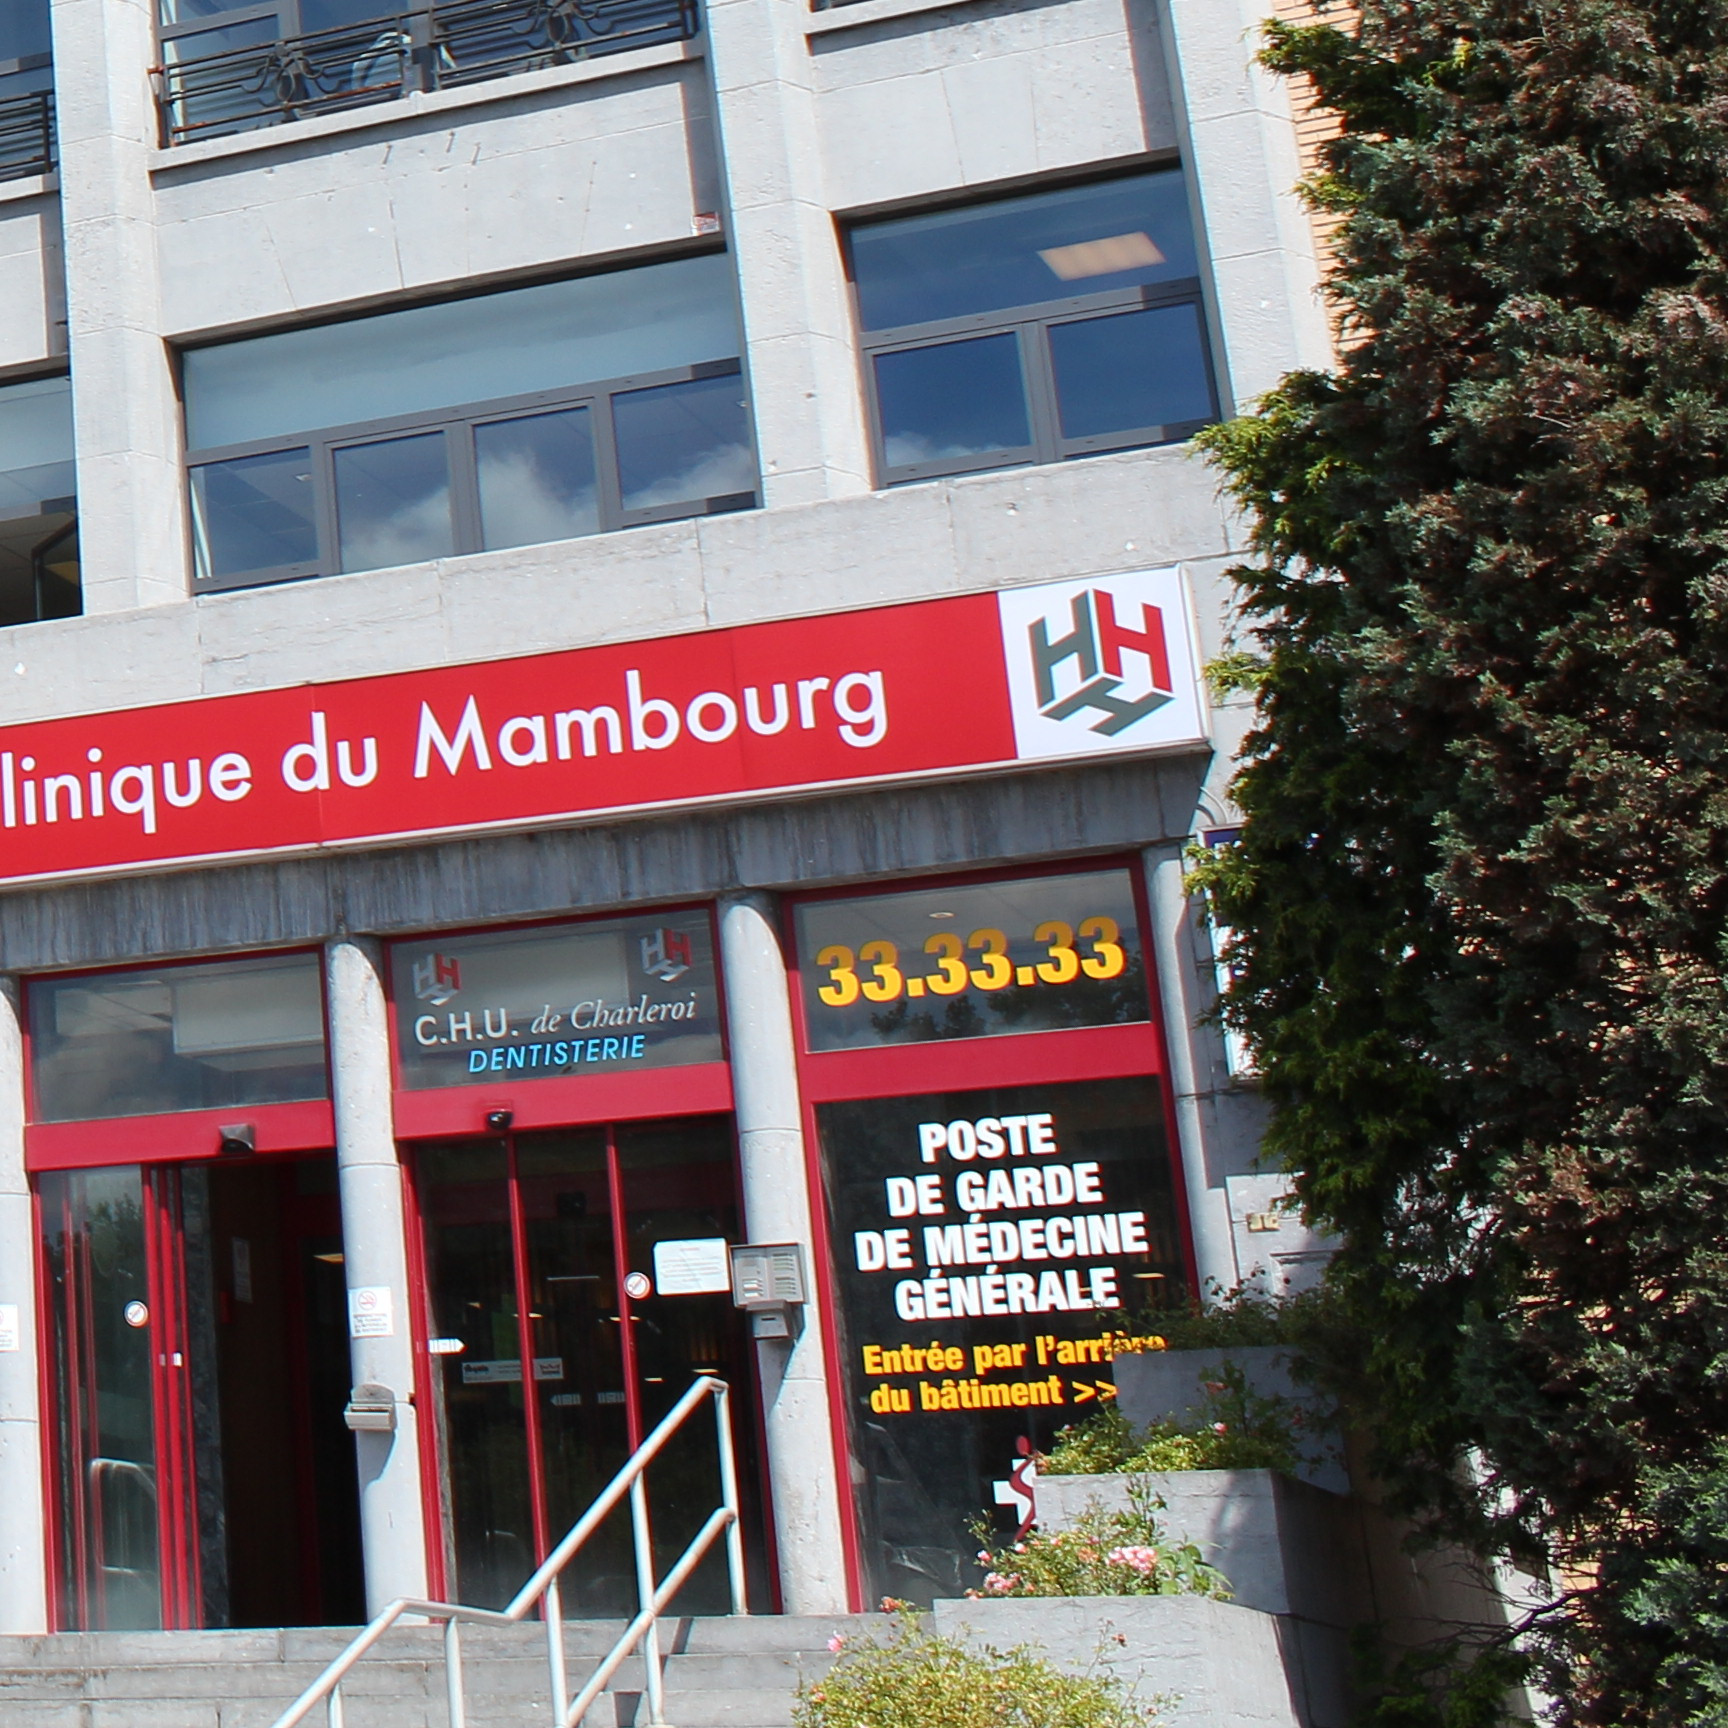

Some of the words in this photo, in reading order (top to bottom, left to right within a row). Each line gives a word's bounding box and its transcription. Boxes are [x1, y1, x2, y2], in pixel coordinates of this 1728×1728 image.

[282, 711, 379, 792] du
[414, 669, 888, 779] Mambourg
[816, 915, 1125, 1007] 33.33.33
[414, 1008, 519, 1046] C.H.U.
[531, 1004, 562, 1034] de
[571, 992, 697, 1030] Charleroi
[469, 1034, 645, 1073] DENTISTERIE
[918, 1113, 1056, 1163] POSTE
[885, 1174, 945, 1217] DE
[956, 1162, 1104, 1212] GARDE
[854, 1228, 914, 1271] DE
[923, 1211, 1150, 1267] MÉDECINE
[894, 1265, 1121, 1322] GÉNÉRALE
[862, 1341, 964, 1375] Entrée
[973, 1337, 1027, 1375] par
[869, 1383, 912, 1413] du
[919, 1375, 1064, 1411] bâtiment
